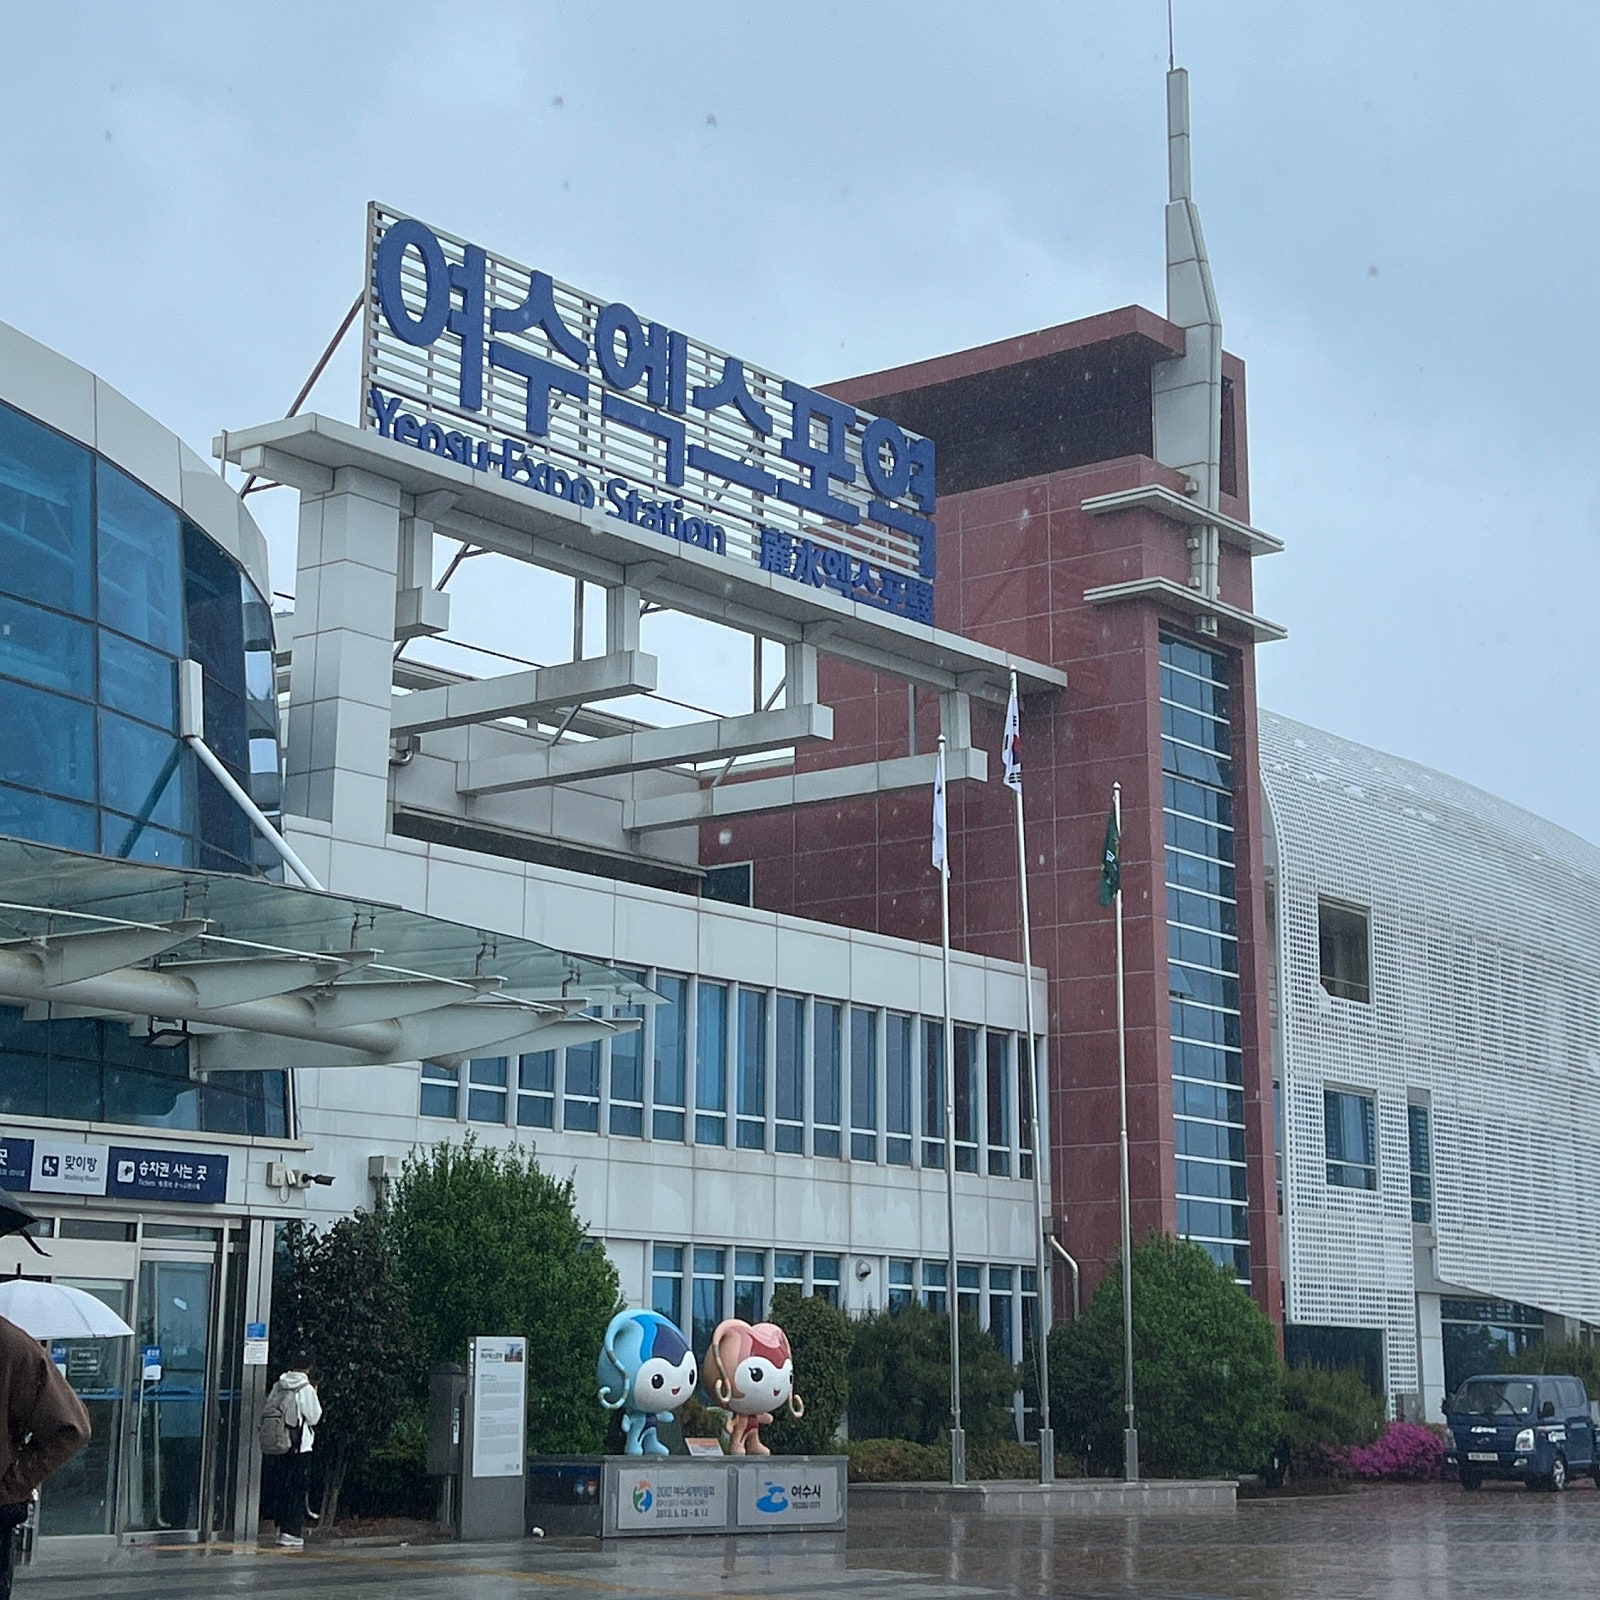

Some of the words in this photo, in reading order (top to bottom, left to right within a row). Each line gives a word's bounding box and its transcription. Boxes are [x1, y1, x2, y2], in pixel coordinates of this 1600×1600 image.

[376, 218, 936, 579] 여수엑스포역
[369, 386, 596, 509] Yeosu-Expo
[604, 477, 728, 556] Station
[65, 1155, 98, 1173] 맞이방
[139, 1160, 170, 1178] 승차권
[173, 1163, 193, 1180] 사는
[197, 1165, 207, 1181] 곳
[791, 1484, 821, 1499] 여수시
